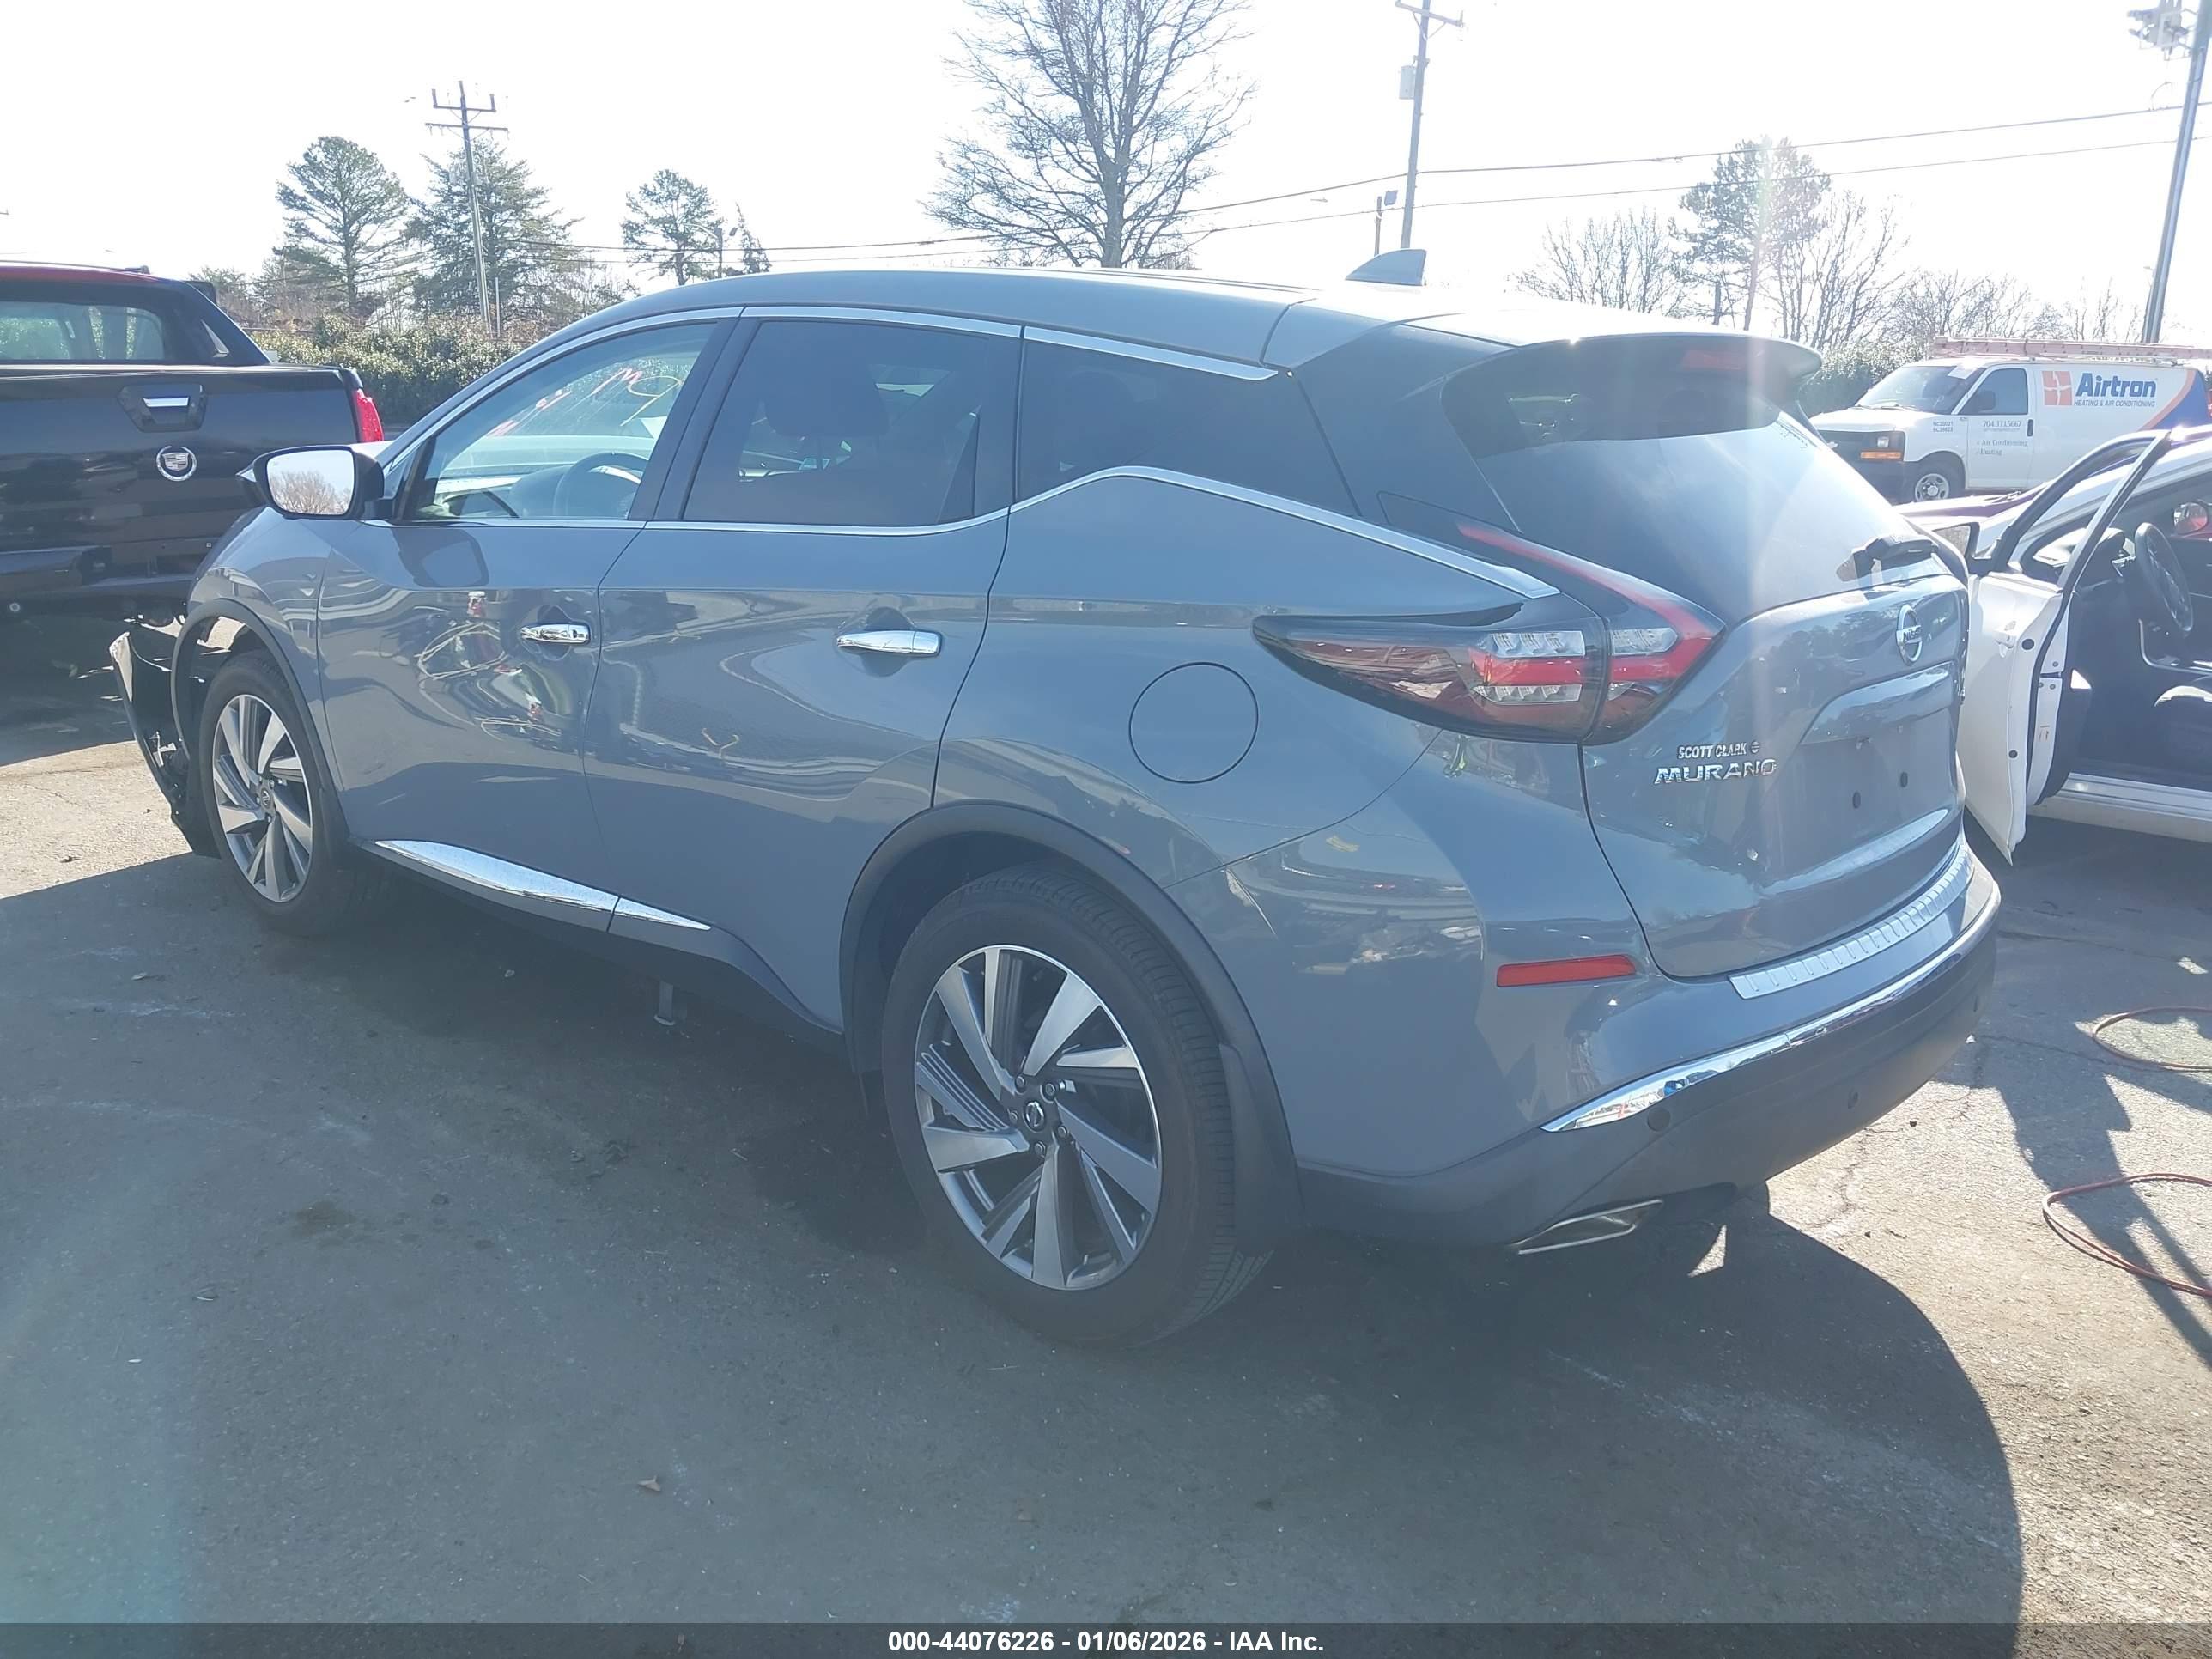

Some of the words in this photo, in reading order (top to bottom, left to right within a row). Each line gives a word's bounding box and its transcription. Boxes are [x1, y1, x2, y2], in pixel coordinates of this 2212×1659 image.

[2075, 372, 2157, 398] Airtron
[2115, 399, 2156, 408] CONDITIONING
[1677, 744, 1714, 759] SCOTT
[1714, 742, 1747, 757] CLARK
[1653, 757, 1778, 785] MURANO
